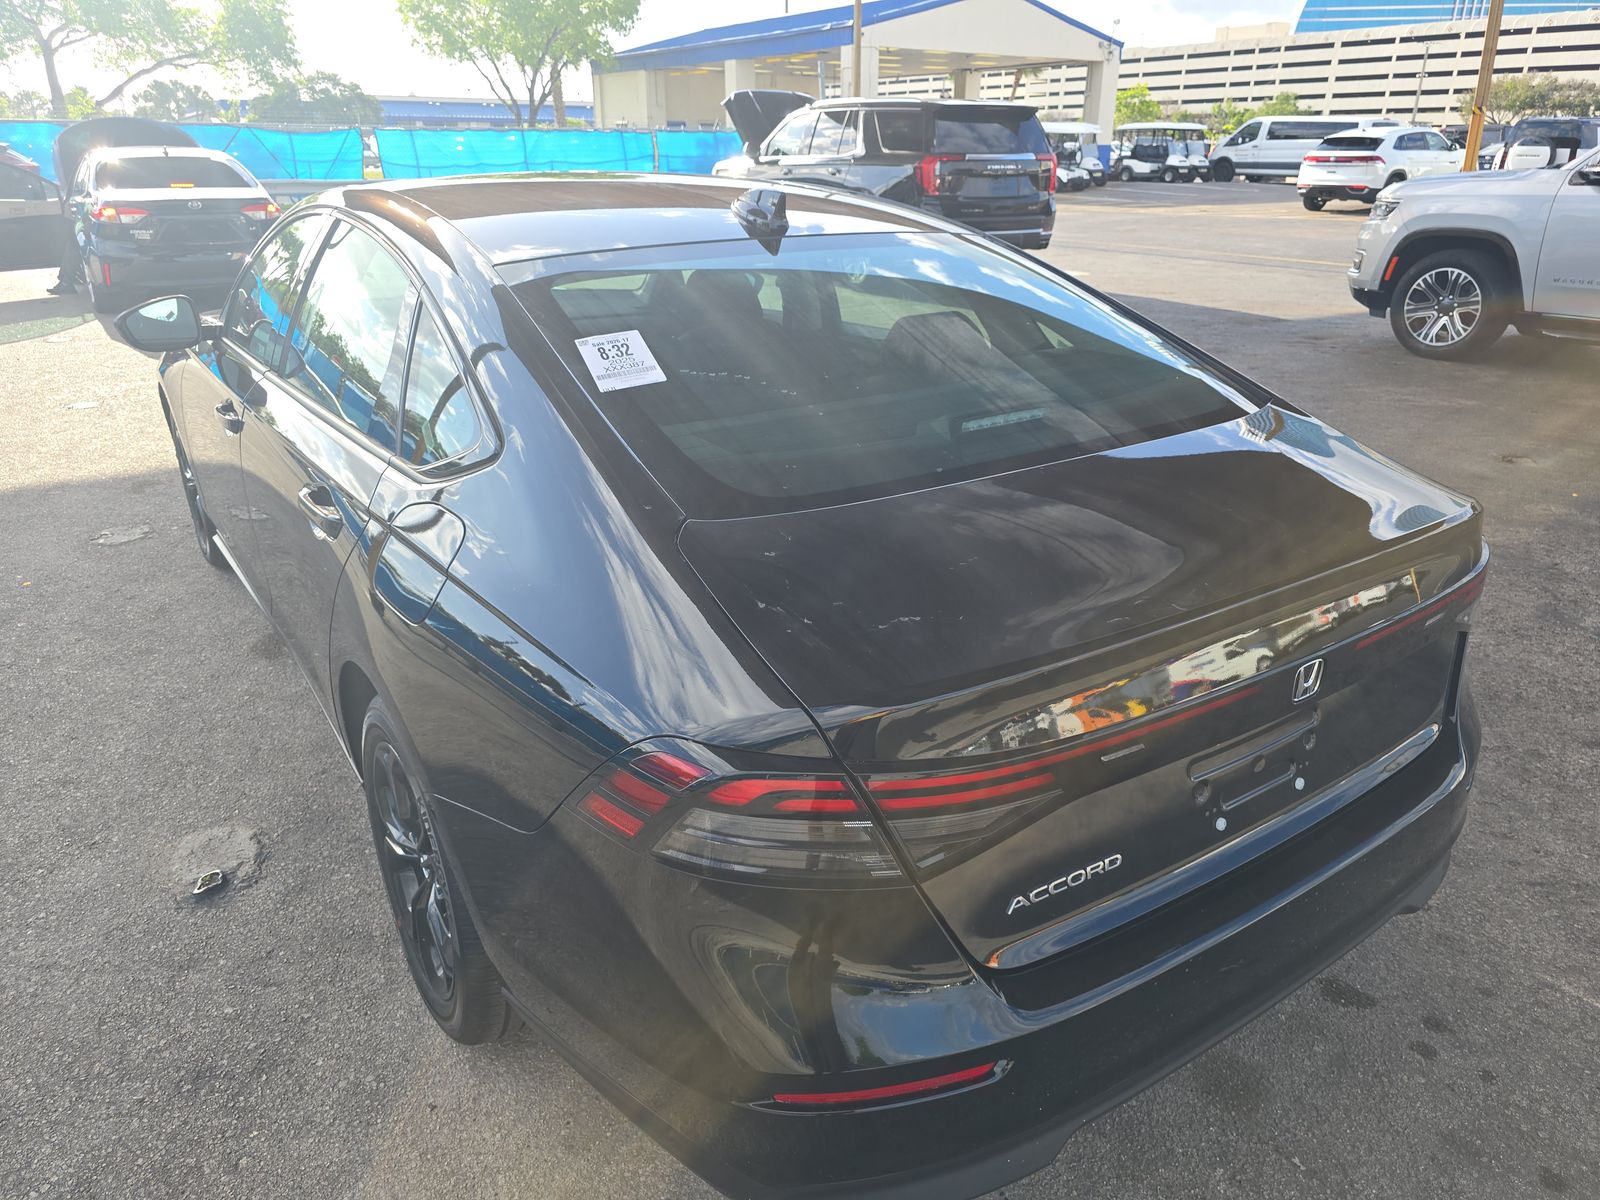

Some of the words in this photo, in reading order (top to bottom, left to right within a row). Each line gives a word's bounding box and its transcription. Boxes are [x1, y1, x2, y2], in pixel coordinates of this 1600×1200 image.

[597, 343, 634, 361] 8:32
[608, 357, 636, 366] 2025
[1007, 853, 1123, 915] ACCORD
